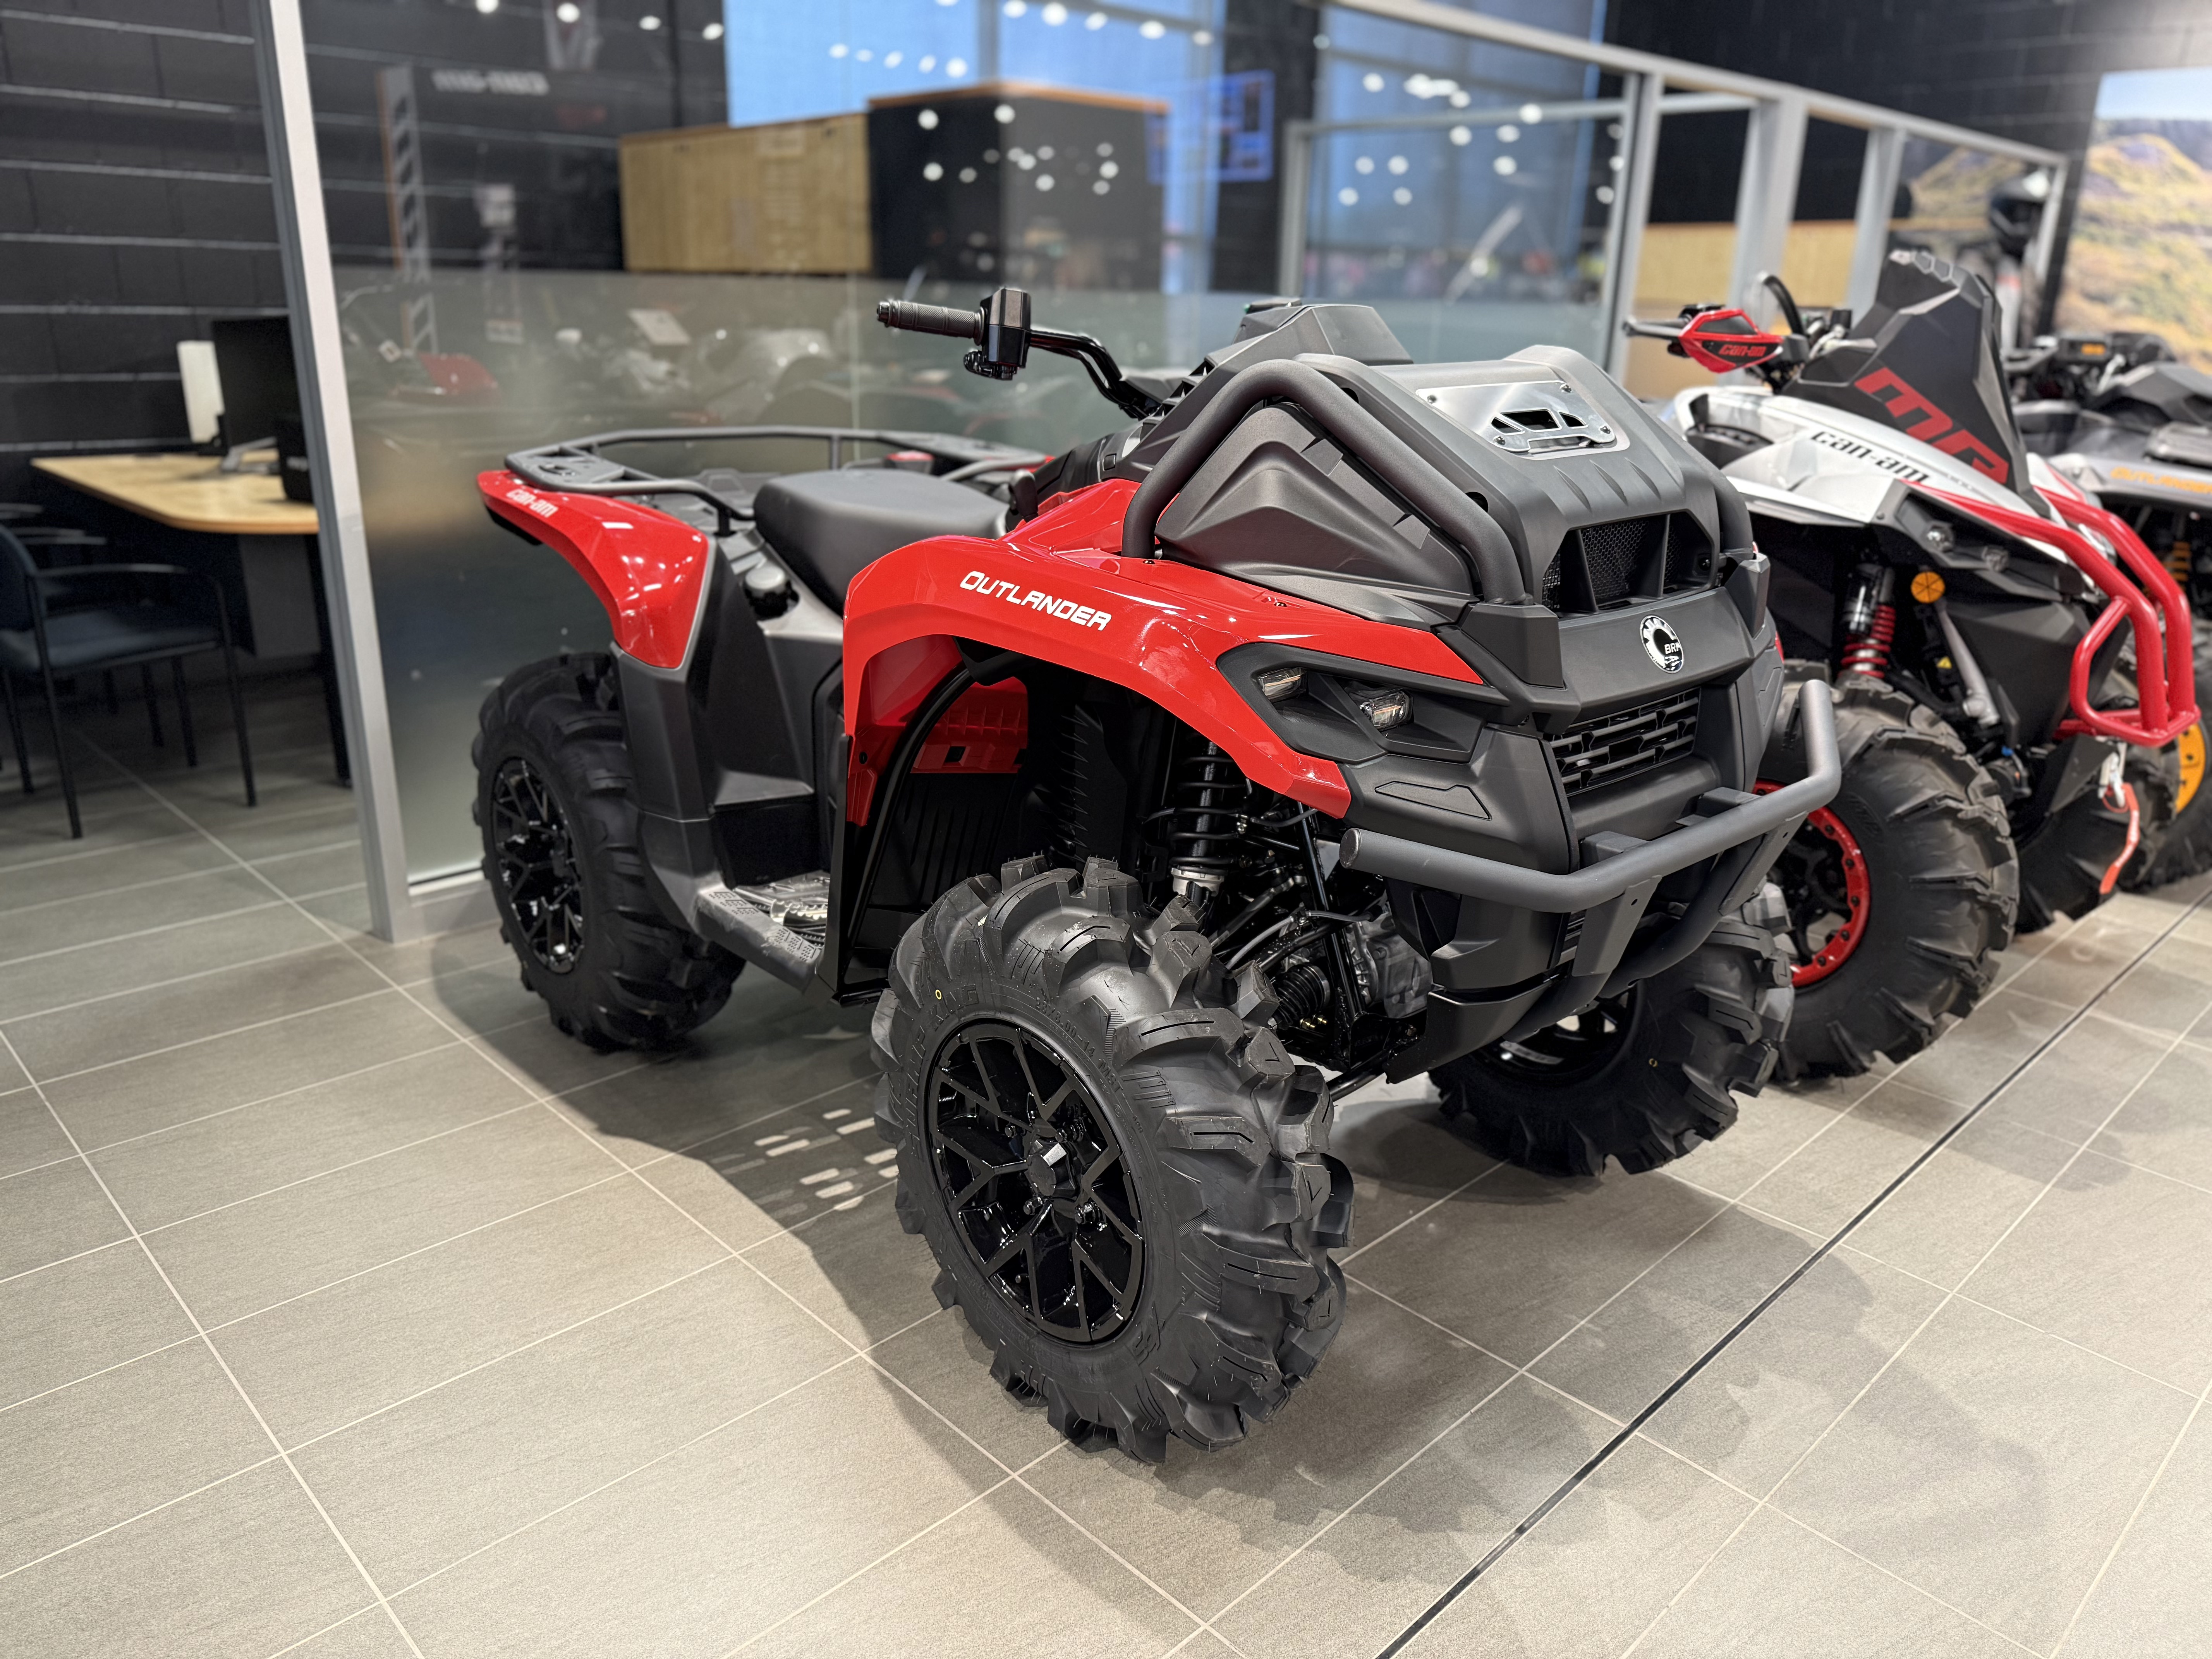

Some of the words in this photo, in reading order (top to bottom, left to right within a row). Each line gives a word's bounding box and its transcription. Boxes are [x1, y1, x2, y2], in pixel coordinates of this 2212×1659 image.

[1810, 431, 1930, 482] can-am
[506, 489, 558, 518] can-am
[960, 570, 1112, 631] OUTLANDER
